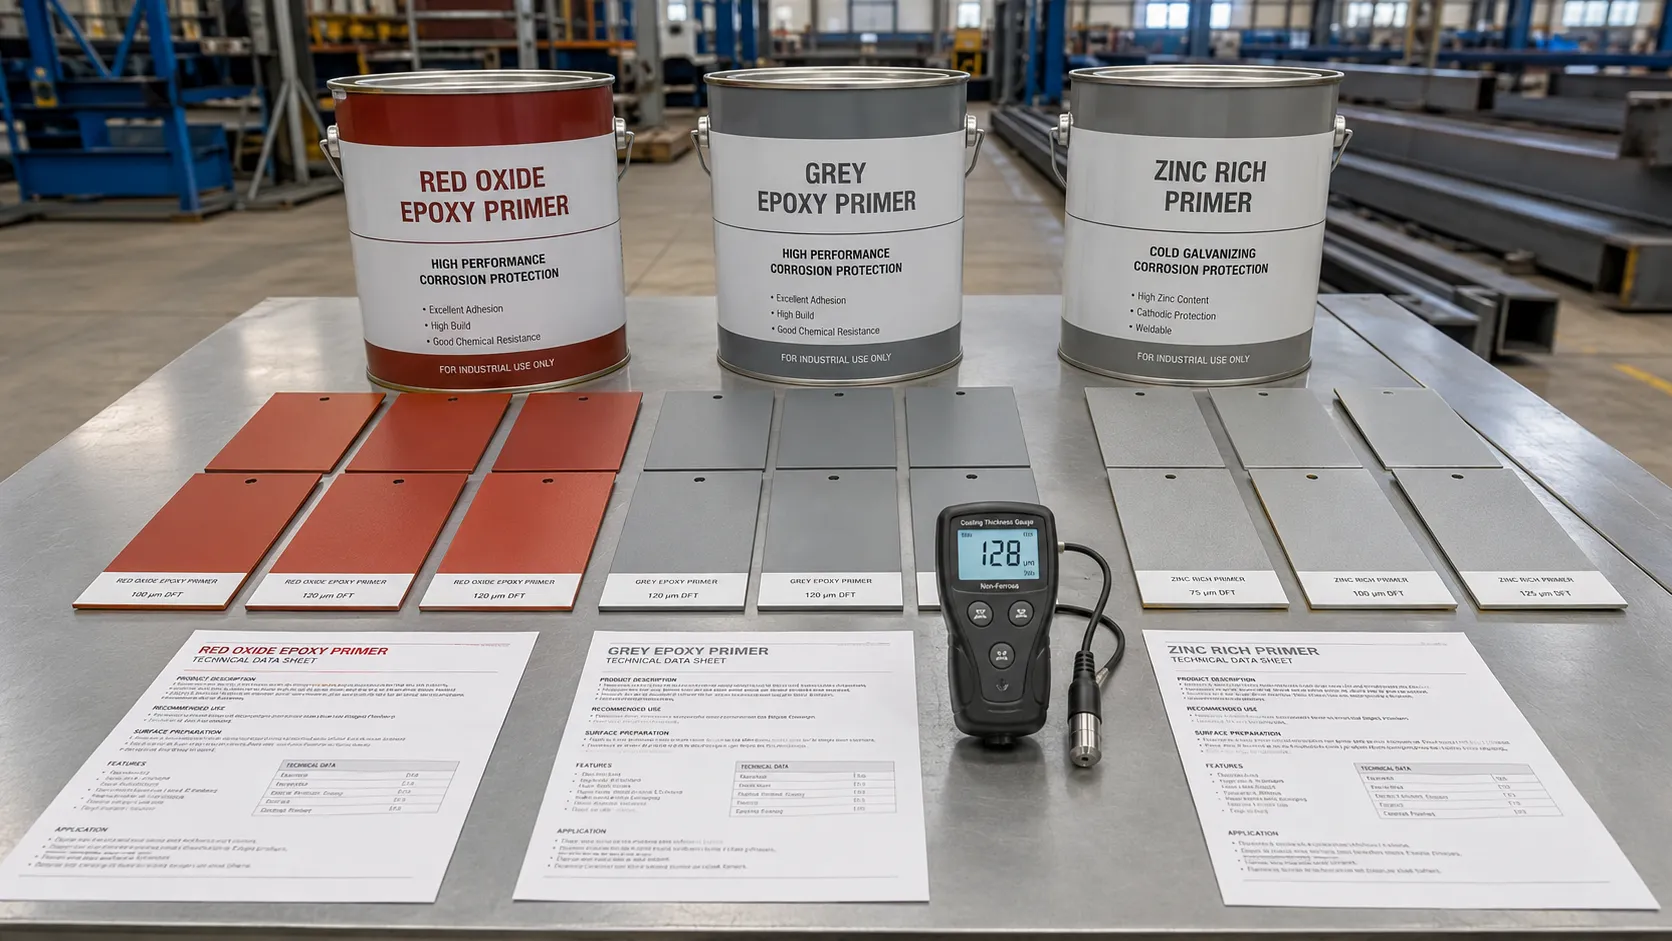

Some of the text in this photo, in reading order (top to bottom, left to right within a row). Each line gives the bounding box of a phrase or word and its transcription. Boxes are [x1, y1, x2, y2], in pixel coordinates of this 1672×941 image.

[805, 162, 866, 184] GREY
[1154, 160, 1266, 183] ZINC RICH
[420, 167, 545, 192] RED OXIDE
[758, 190, 916, 214] EPOXY PRIMER
[1164, 191, 1252, 213] PRIMER
[400, 194, 569, 223] EPOXY PRIMER
[782, 248, 890, 260] HIGH PERFORMANCE
[1150, 246, 1256, 259] COLD GALVANIZING
[431, 254, 546, 269] HIGH PERFORMANCE
[771, 263, 902, 276] CORROSION PROTECTION
[1134, 261, 1268, 275] CORROSION PROTECTION
[420, 268, 559, 285] CORROSION PROTECTION
[776, 294, 846, 305] Excellent Adhesion
[1138, 292, 1209, 304] High Zinc Content
[429, 304, 503, 314] Excellent Adhesion
[777, 310, 814, 320] High Build
[1137, 308, 1216, 320] Cathodic Protection
[431, 322, 471, 332] High Build
[777, 325, 880, 336] Good Chemical Resistance
[1136, 324, 1172, 335] Weldable
[433, 333, 541, 346] Good Chemical Resistance
[781, 353, 891, 364] FOR INDUSTRIAL USE ONLY
[1137, 352, 1250, 365] FOR INDUSTRIAL USE ONLY
[439, 359, 555, 374] FOR INDUSTRIAL USE ONLY
[982, 540, 1021, 567] 128
[198, 646, 388, 656] RED OXIDE EPOXY PRIMER
[607, 647, 769, 656] GREY EPOXY PRIMER
[1168, 645, 1320, 656] ZINC RICH PRIMER
[192, 656, 250, 664] TECHNICAL
[283, 656, 318, 664] SHEET
[1171, 656, 1229, 664] TECHNICAL
